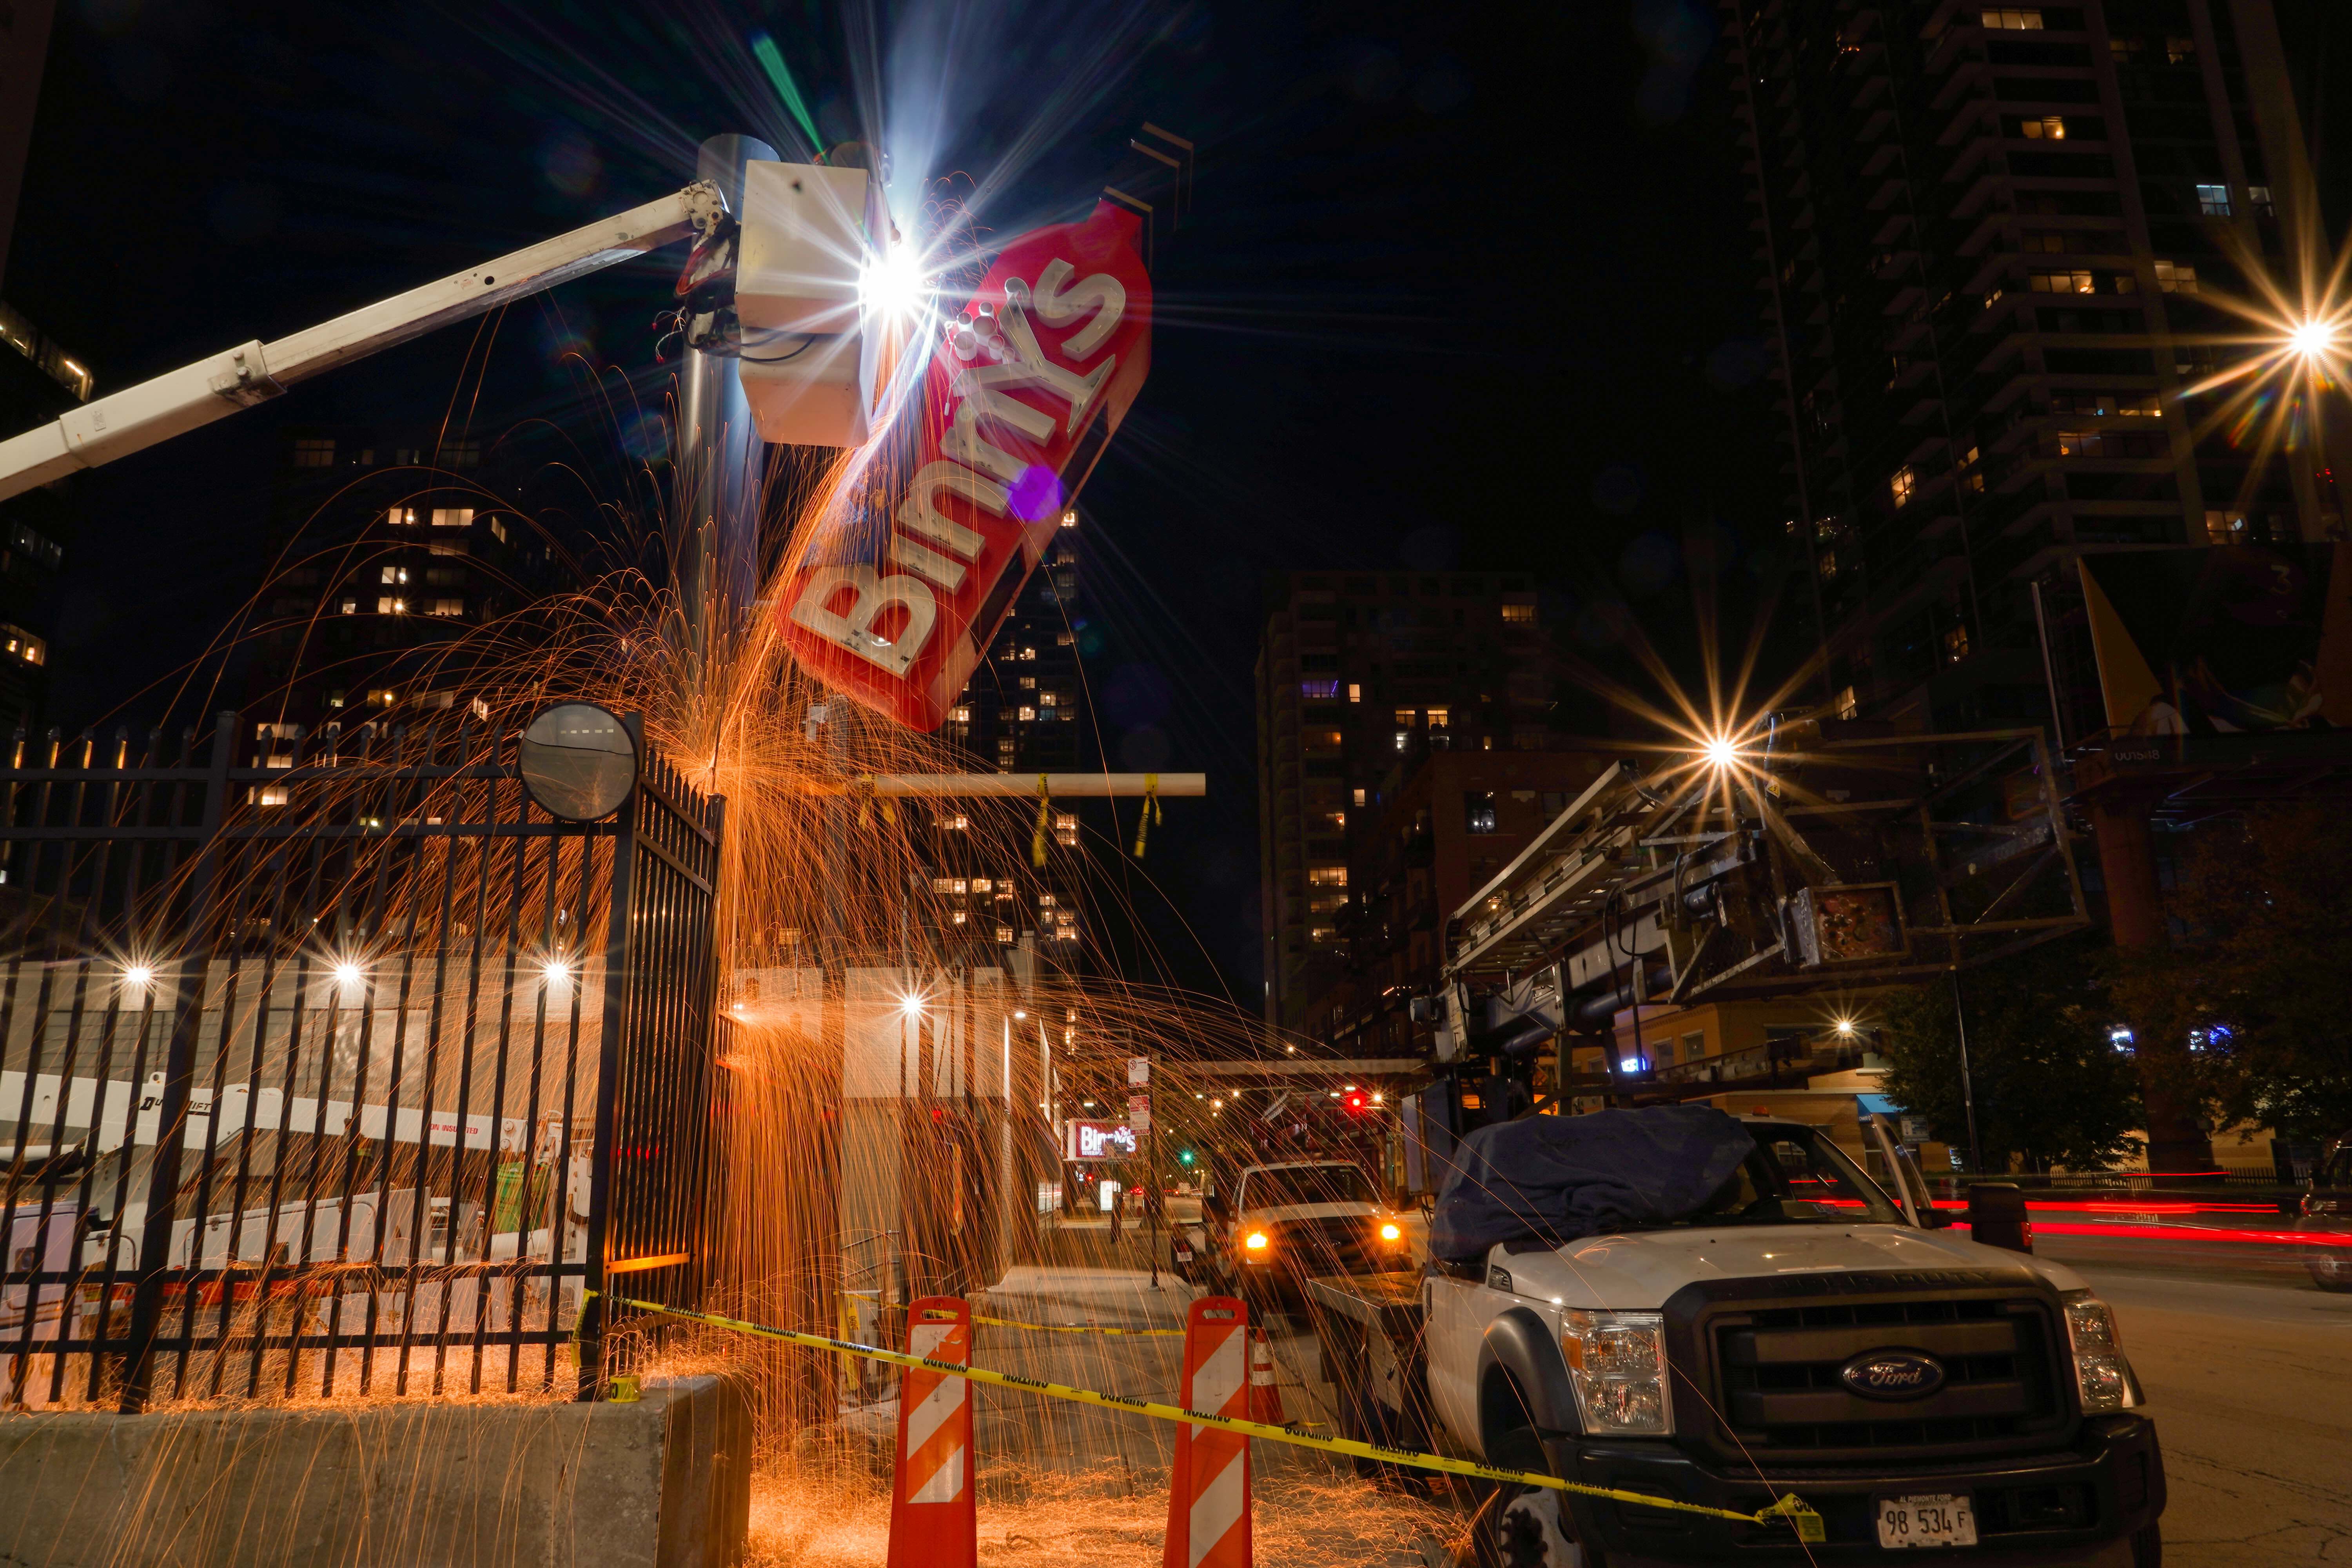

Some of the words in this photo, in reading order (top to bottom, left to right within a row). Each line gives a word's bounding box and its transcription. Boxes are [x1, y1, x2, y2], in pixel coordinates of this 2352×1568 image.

[442, 1124, 478, 1134] INSUTED
[1869, 1362, 1922, 1386] Ford
[1886, 1510, 1909, 1536] 98
[1917, 1508, 1952, 1534] 534
[1957, 1511, 1966, 1528] F
